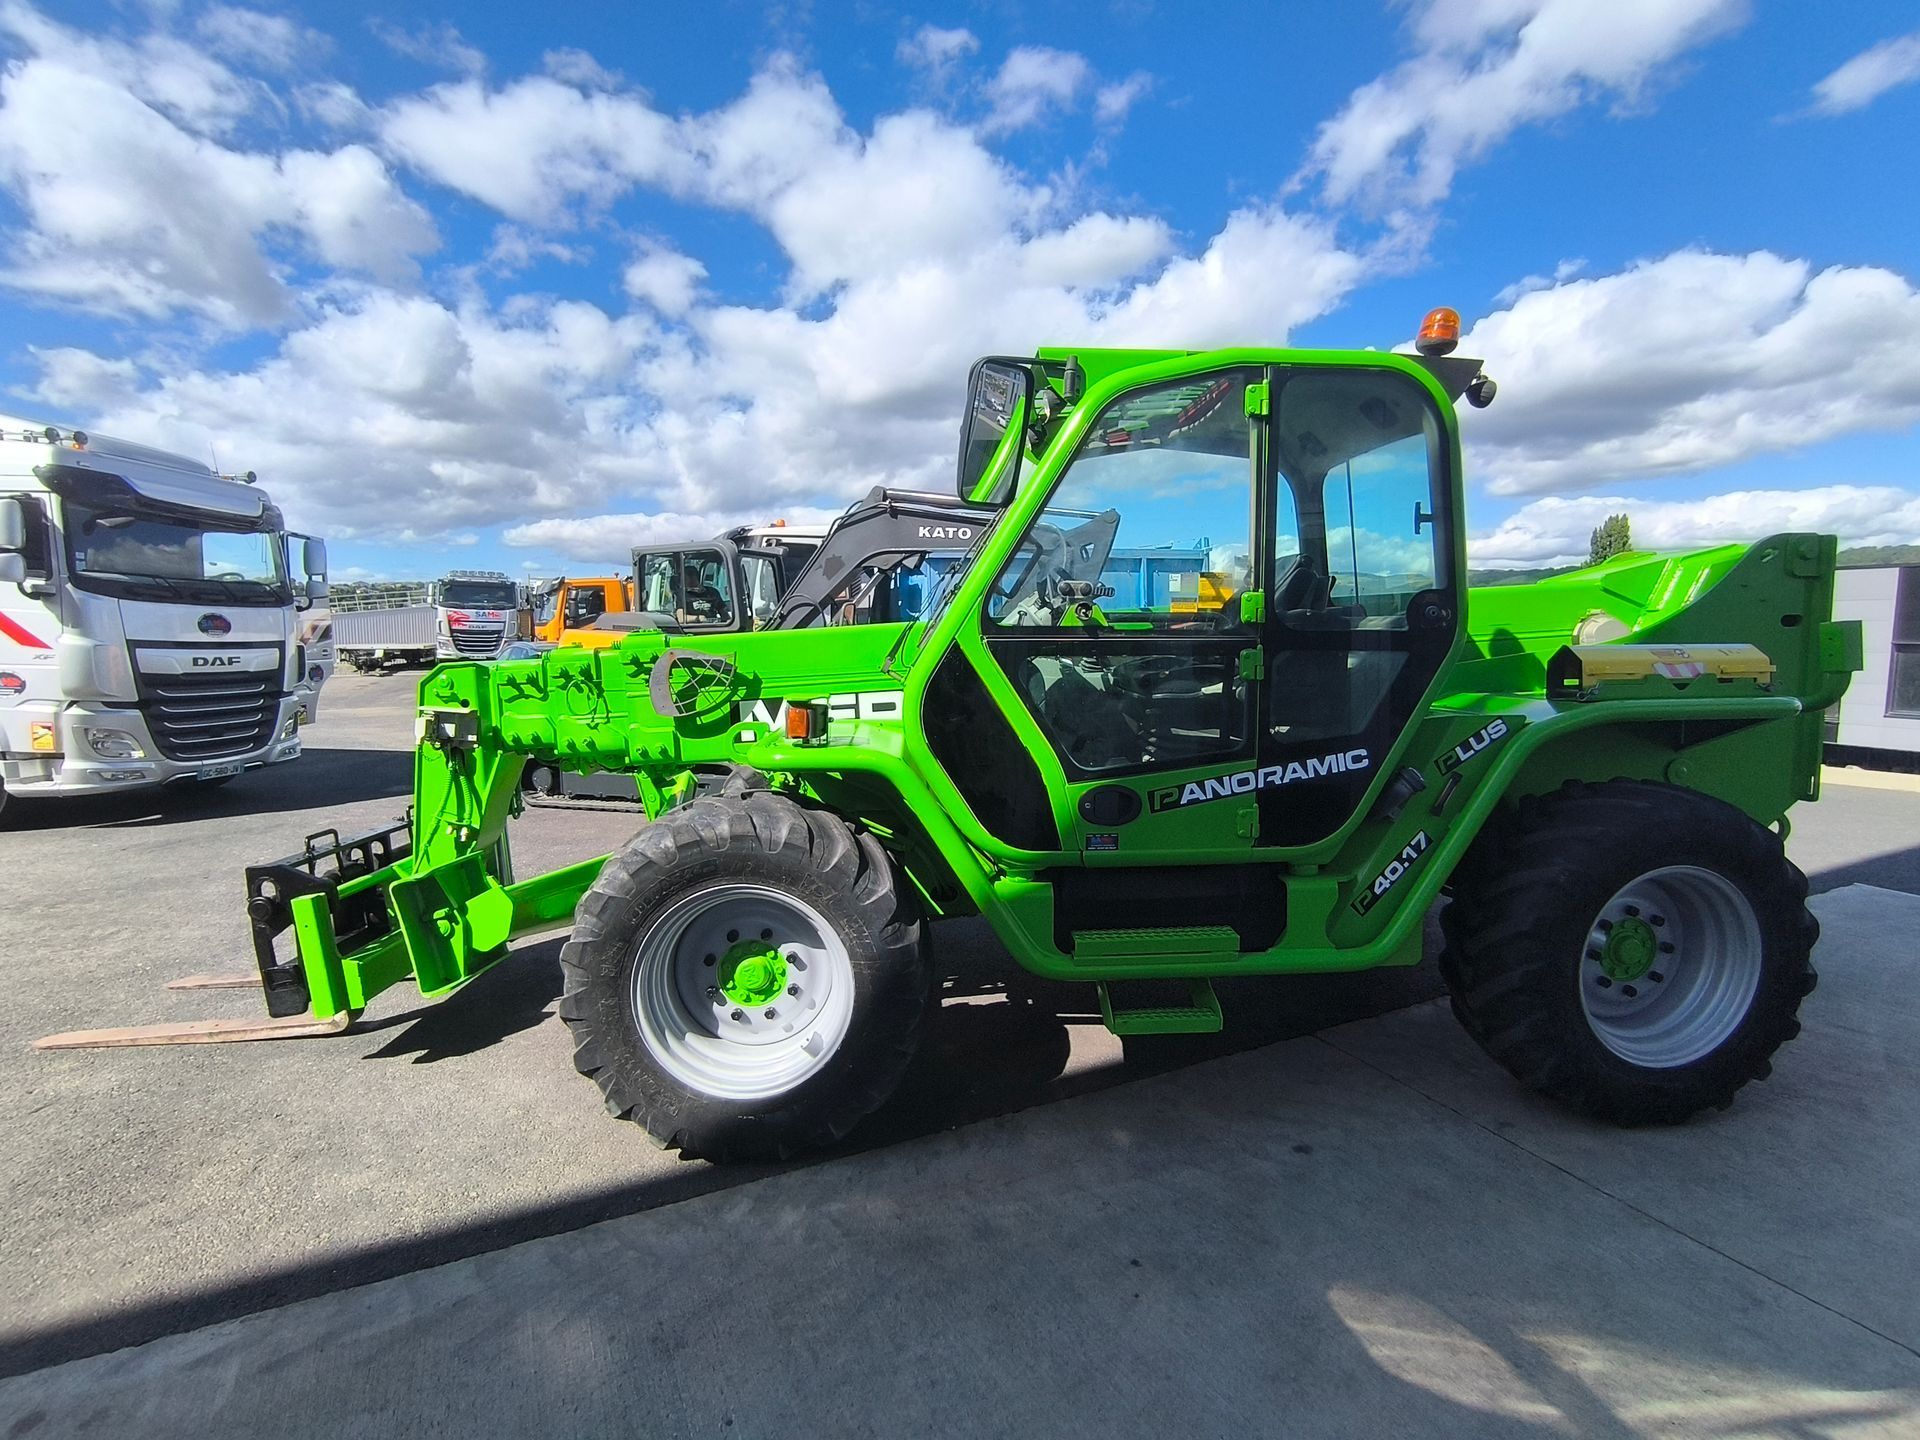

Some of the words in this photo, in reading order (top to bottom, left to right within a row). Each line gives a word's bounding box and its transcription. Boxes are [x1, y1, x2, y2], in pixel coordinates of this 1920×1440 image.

[918, 526, 972, 540] KATO
[192, 656, 241, 667] DAF
[1437, 719, 1507, 774] PLUS
[1154, 748, 1369, 810] PANORAMIC
